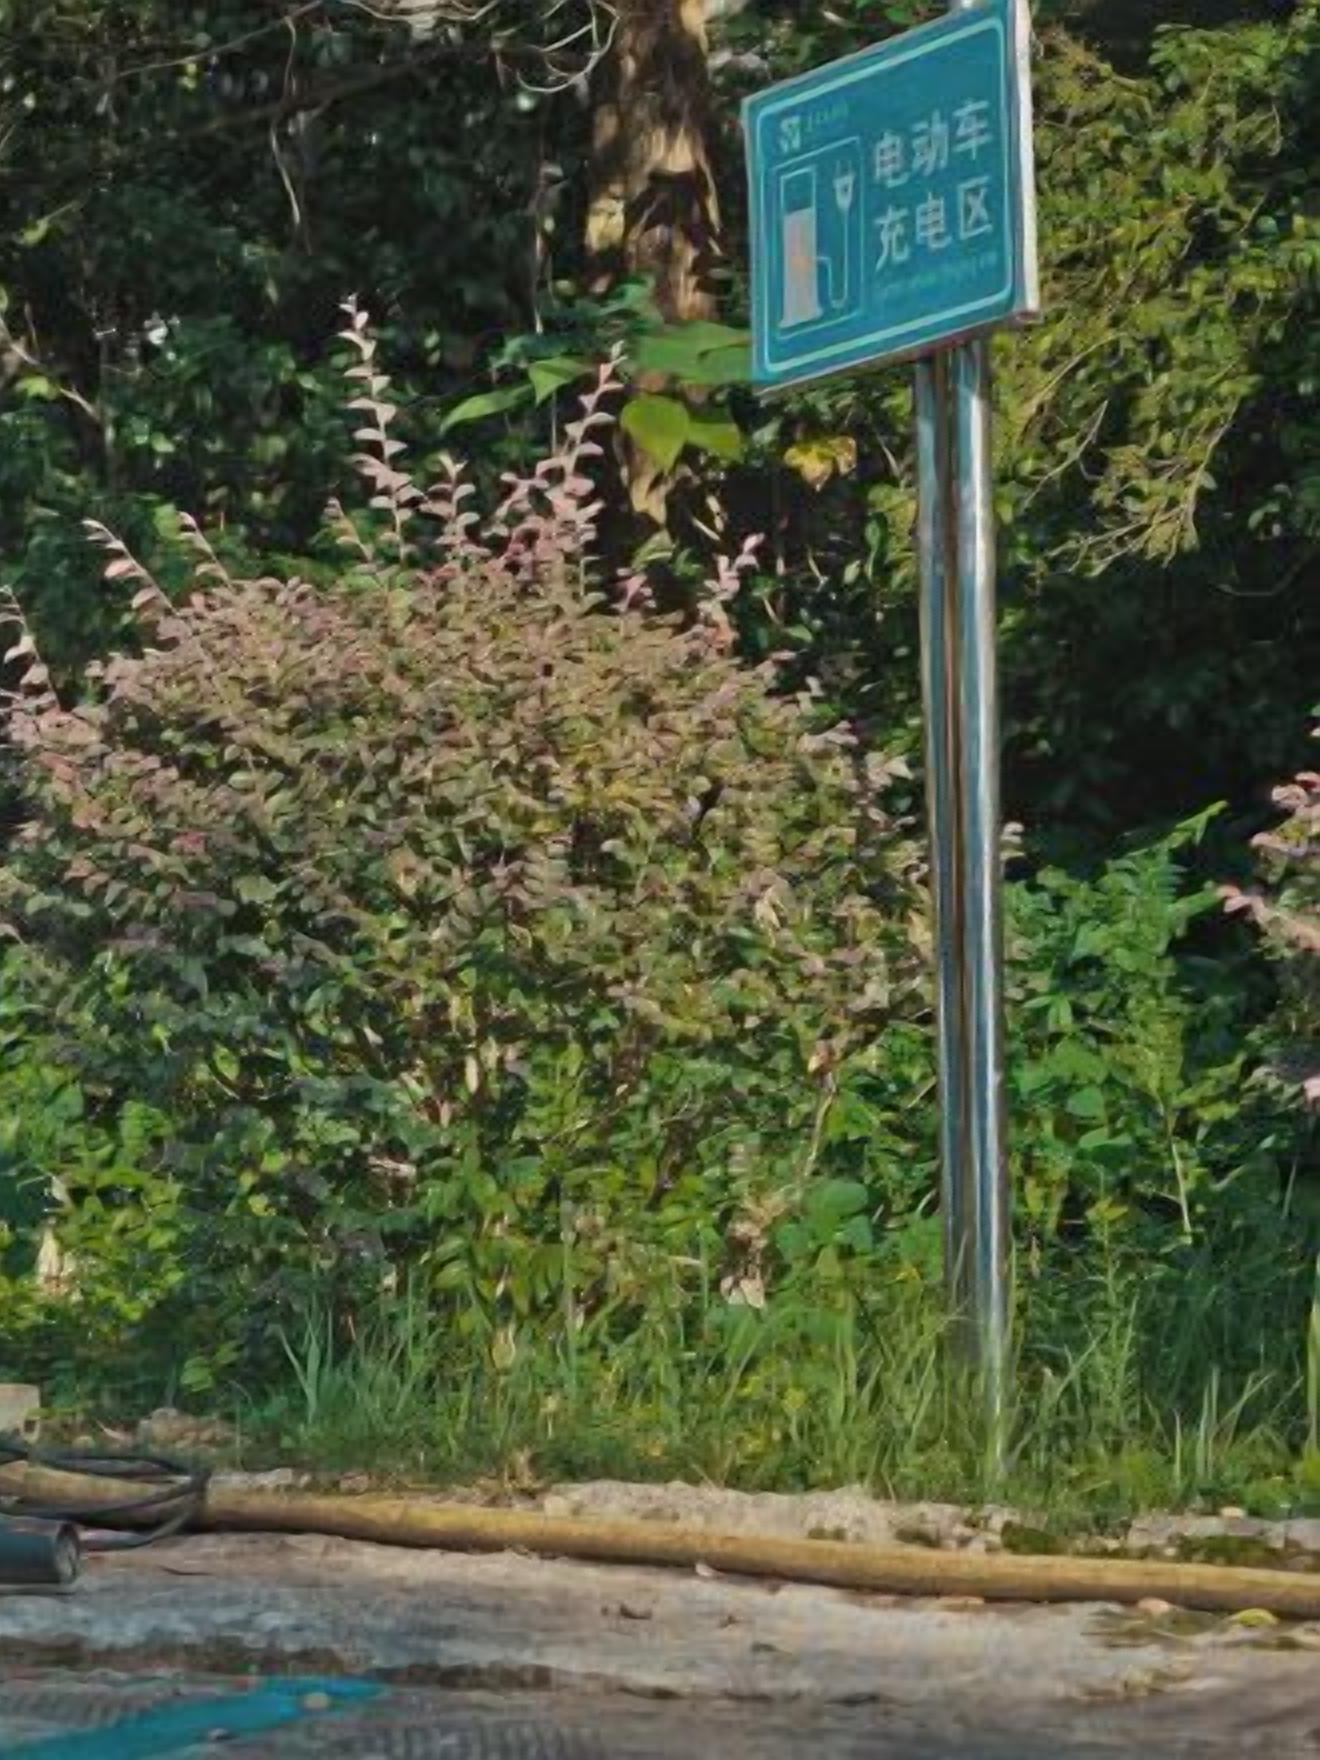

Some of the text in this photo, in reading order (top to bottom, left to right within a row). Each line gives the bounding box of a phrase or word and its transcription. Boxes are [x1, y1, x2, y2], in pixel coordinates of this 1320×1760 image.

[873, 98, 992, 188] 电动车
[875, 176, 992, 270] 充电区
